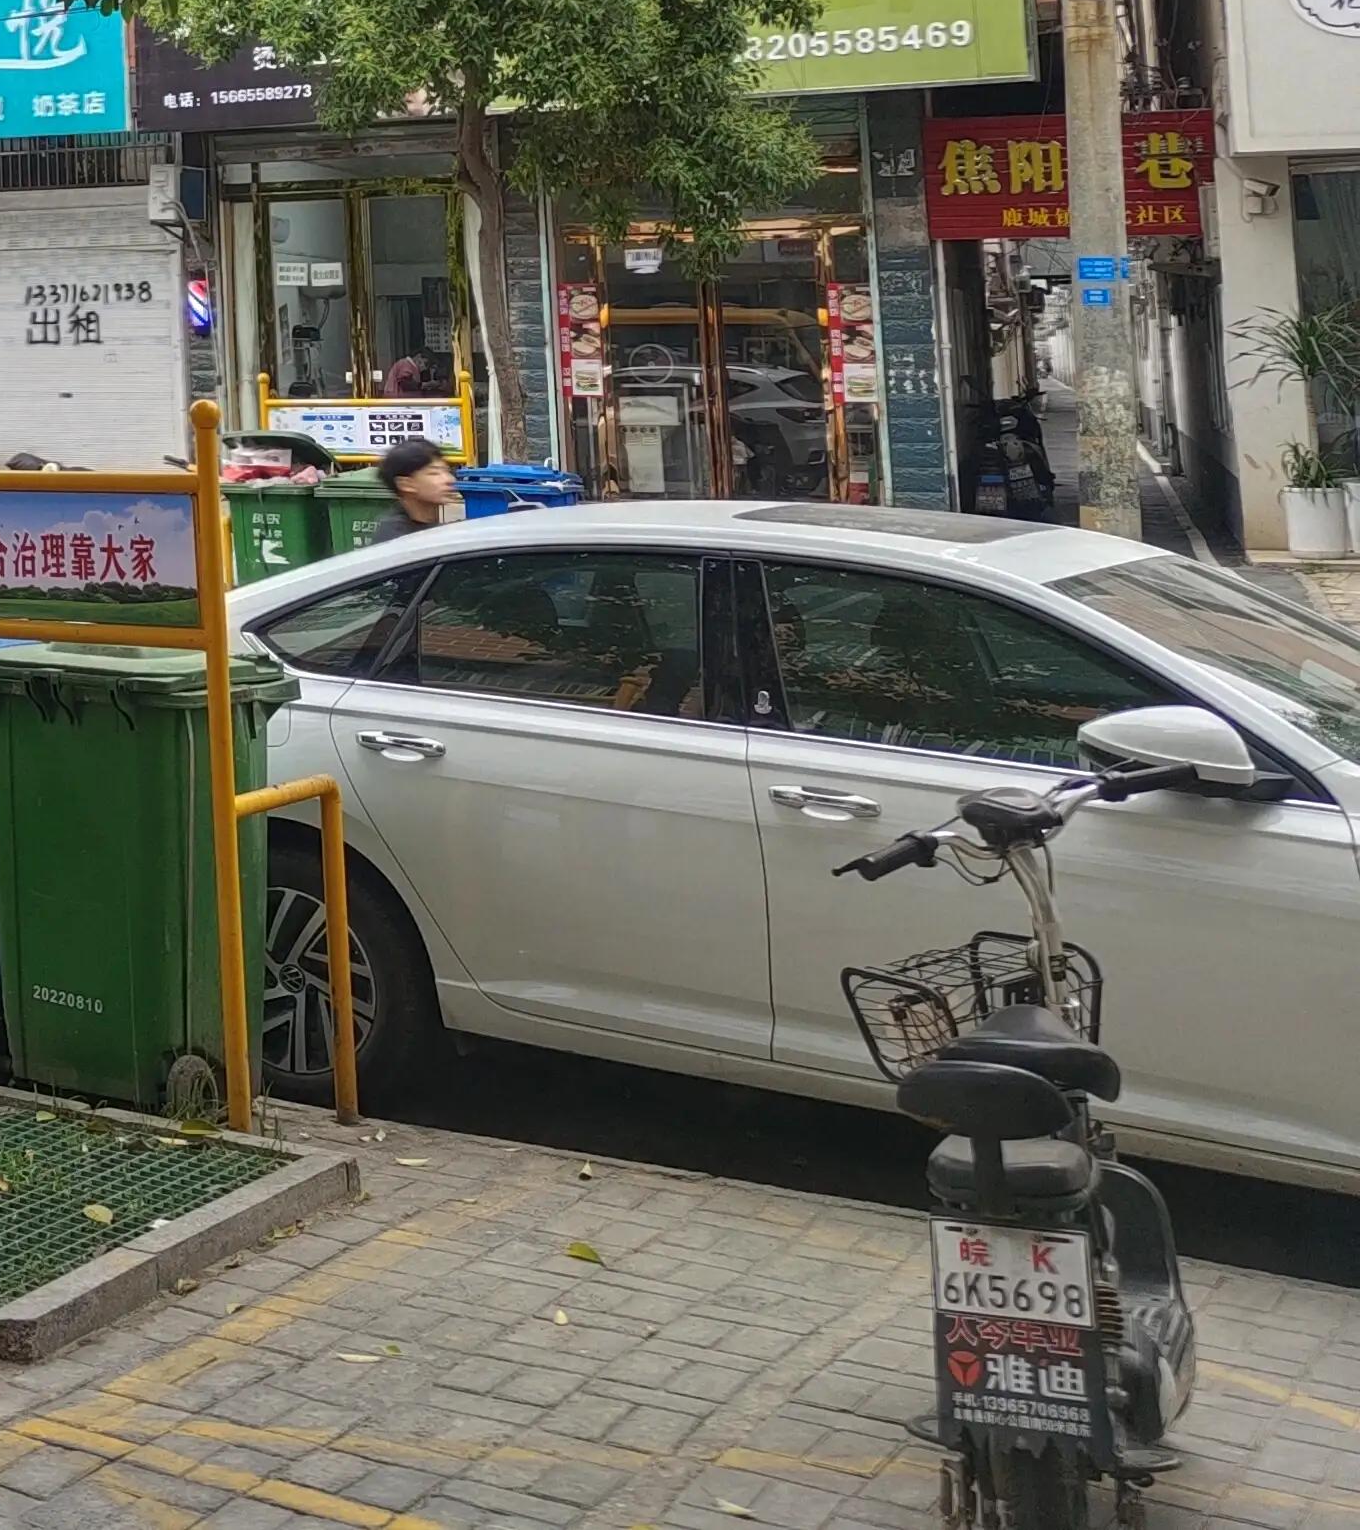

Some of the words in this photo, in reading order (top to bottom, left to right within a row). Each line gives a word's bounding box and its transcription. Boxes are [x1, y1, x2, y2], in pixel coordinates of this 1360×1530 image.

[733, 20, 974, 63] 8205585469
[32, 90, 107, 118] 奶茶店
[210, 84, 313, 105] 15665589273
[937, 132, 1195, 196] 焦阳巷
[1002, 204, 1186, 228] 鹿城镇社区
[26, 305, 104, 346] 出租
[32, 984, 104, 1014] 20220810
[959, 1237, 992, 1267] 皖
[1030, 1244, 1060, 1275] K
[943, 1271, 1087, 1319] 6K5698
[984, 1352, 1089, 1403] 雅迪
